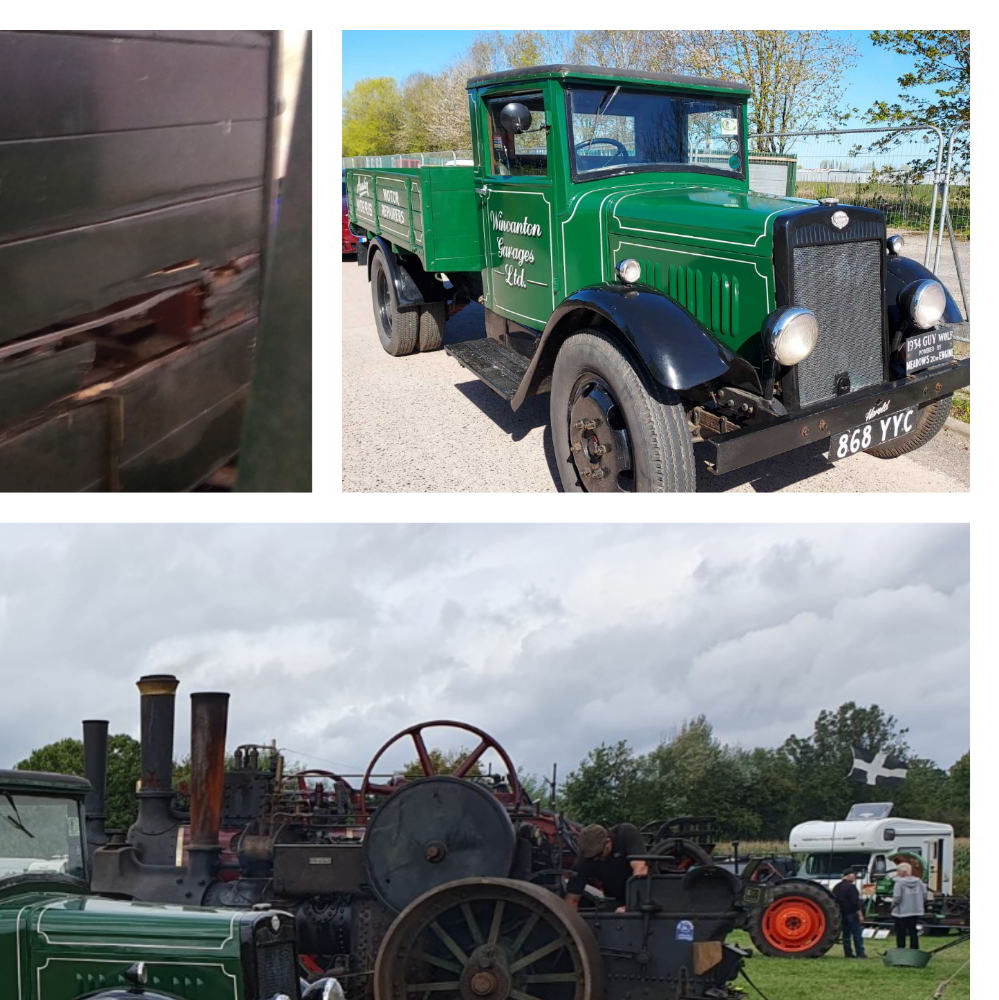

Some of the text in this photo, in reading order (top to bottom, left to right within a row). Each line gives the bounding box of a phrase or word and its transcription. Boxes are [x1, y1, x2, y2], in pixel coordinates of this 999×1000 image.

[382, 188, 400, 205] MOTOR
[490, 210, 542, 237] Wincanton
[496, 236, 535, 266] Garages
[504, 263, 527, 288] Ltd.
[907, 330, 954, 352] 1934 GUY WOLF
[906, 355, 930, 371] MEADOWS
[939, 348, 954, 360] ENGINE
[837, 409, 914, 458] 868 YYC
